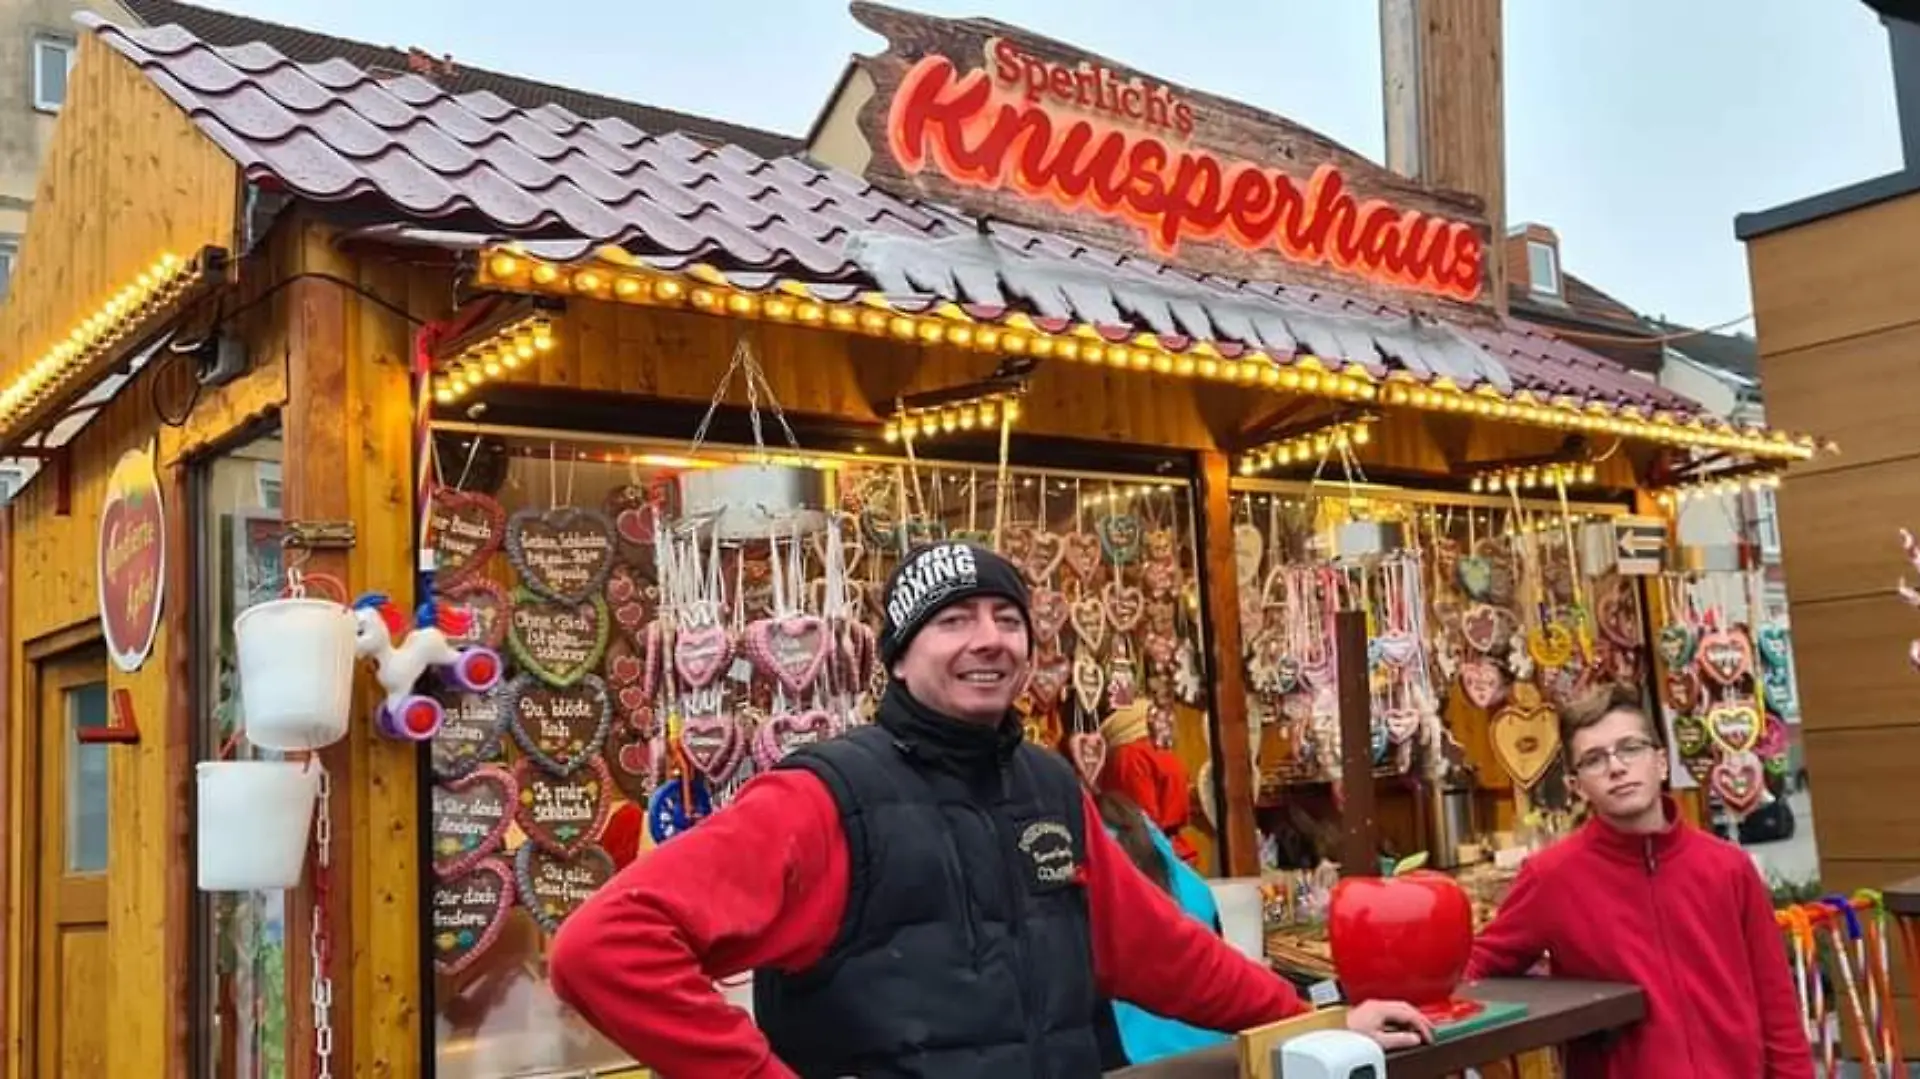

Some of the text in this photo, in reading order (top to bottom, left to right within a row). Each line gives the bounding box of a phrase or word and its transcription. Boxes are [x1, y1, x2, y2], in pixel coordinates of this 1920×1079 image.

[993, 36, 1194, 136] Sperlich's
[889, 54, 1487, 301] Knusperhaus
[888, 556, 976, 628] BOXING
[550, 697, 594, 717] blöde
